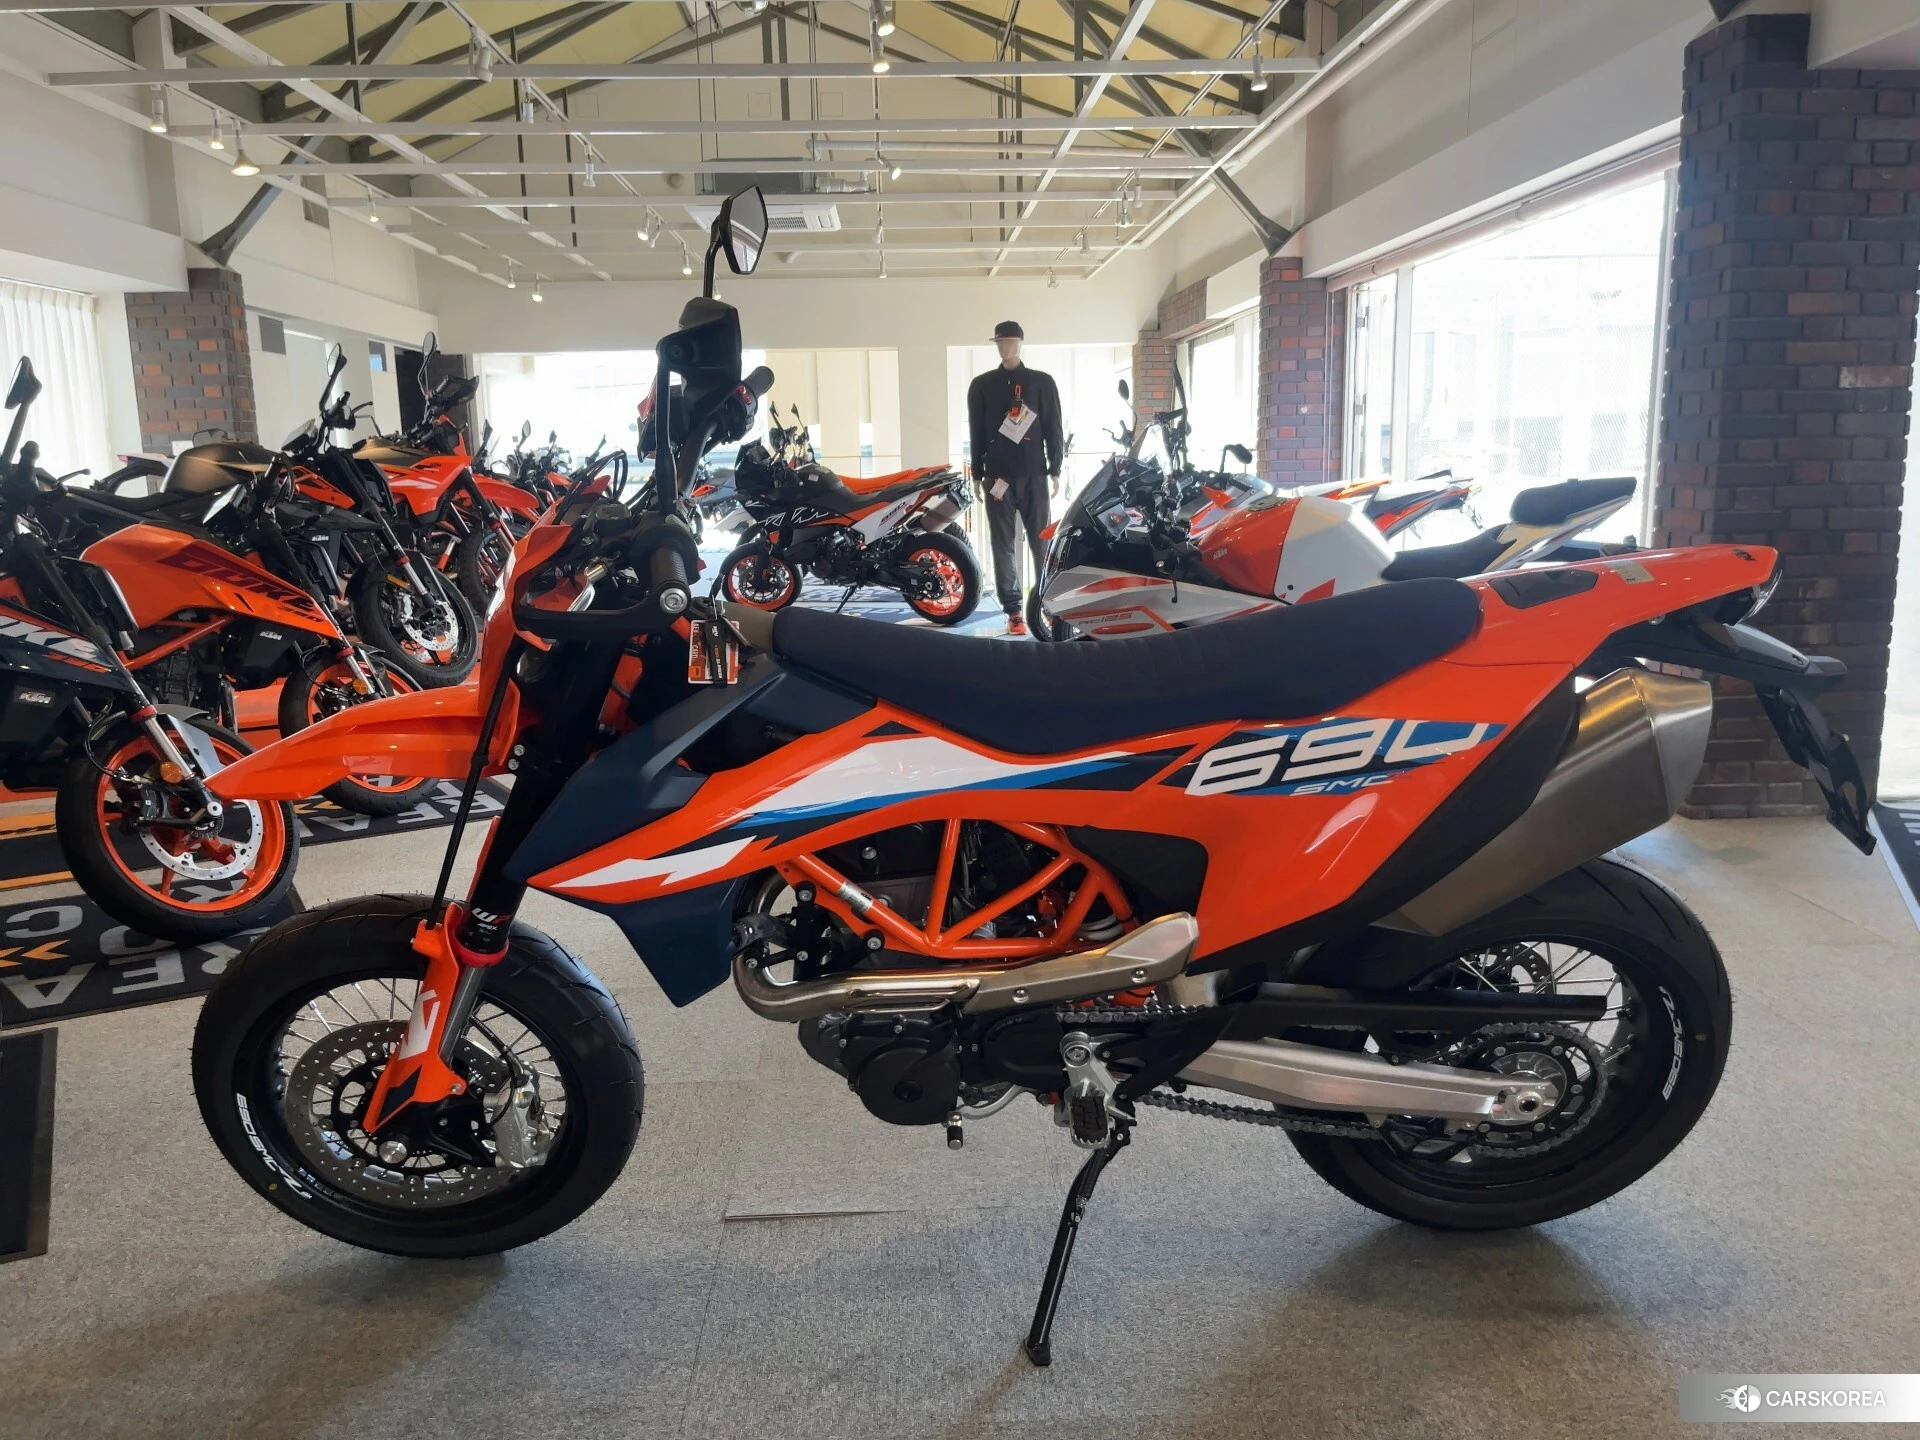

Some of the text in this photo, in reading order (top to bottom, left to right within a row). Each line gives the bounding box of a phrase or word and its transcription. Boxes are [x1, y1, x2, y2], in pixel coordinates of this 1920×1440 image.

[18, 691, 52, 704] KTM
[1184, 718, 1490, 797] 690
[1289, 773, 1394, 797] SMC
